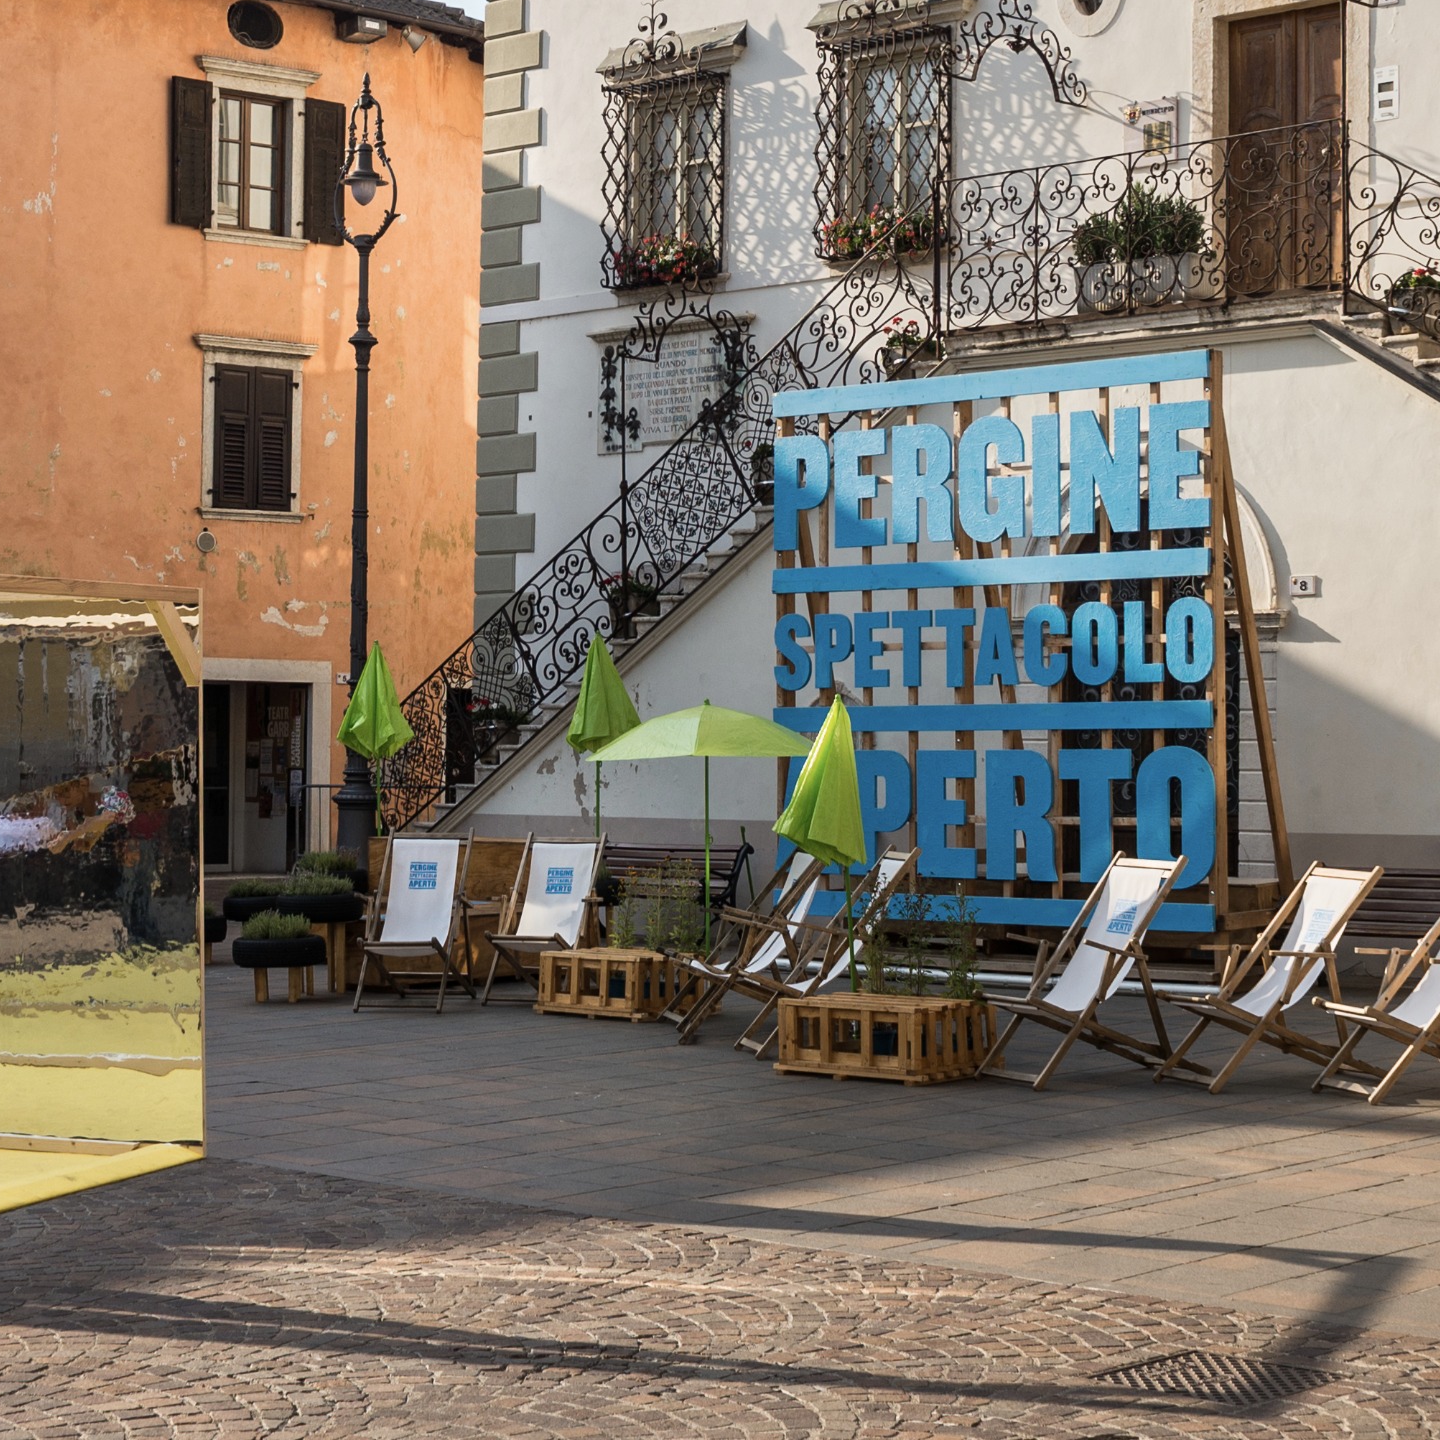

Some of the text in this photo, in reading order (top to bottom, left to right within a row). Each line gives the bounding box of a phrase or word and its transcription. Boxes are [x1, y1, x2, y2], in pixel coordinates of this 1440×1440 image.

[673, 349, 697, 359] NOVEMBRE
[654, 360, 686, 369] QUANDO
[690, 384, 711, 394] ATTESA
[655, 397, 673, 407] QUESTA
[673, 395, 692, 404] PIAZZA
[660, 416, 672, 424] SOLO
[642, 426, 661, 434] VIVA
[773, 400, 1211, 551] PERGINE
[1299, 580, 1308, 591] 8
[774, 596, 1214, 692] SPETTACOLO
[1107, 921, 1133, 932] APERTO
